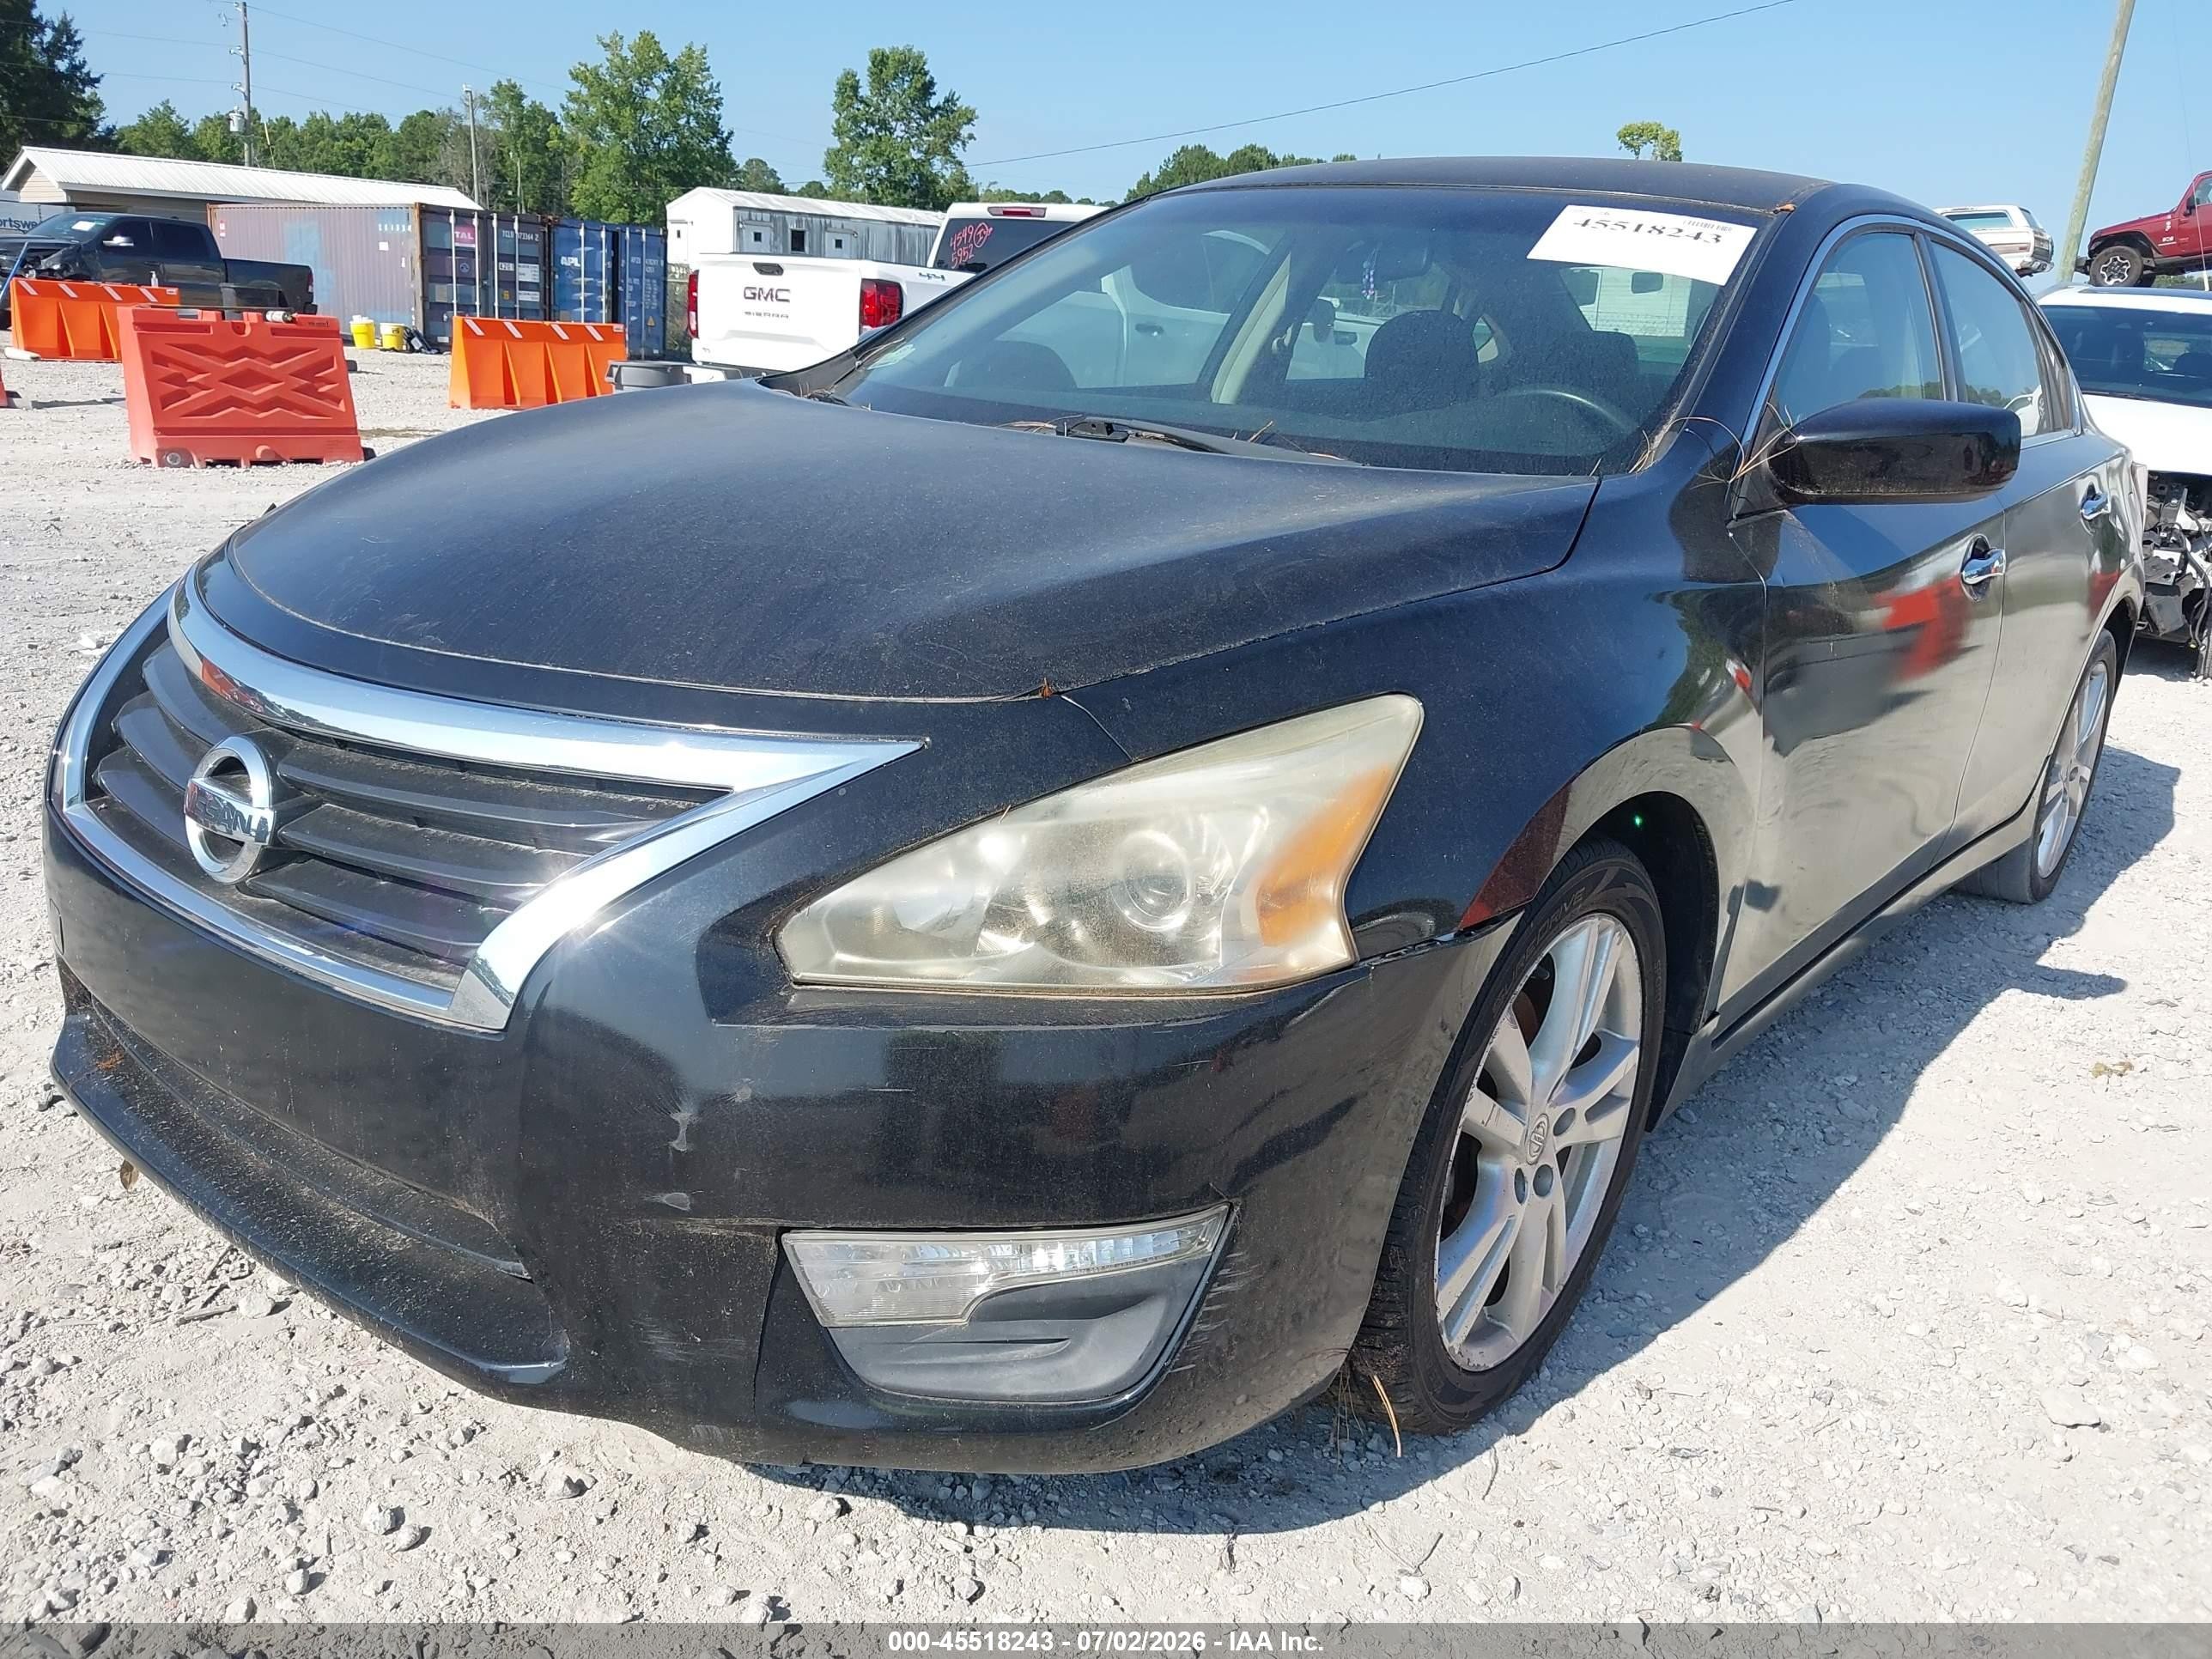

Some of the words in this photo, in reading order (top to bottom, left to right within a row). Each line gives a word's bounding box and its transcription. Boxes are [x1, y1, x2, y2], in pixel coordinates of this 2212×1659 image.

[454, 231, 474, 240] TAL
[950, 225, 974, 251] 4549
[1573, 217, 1723, 244] 45518243
[560, 256, 580, 267] APL
[951, 244, 975, 269] 5952
[744, 286, 790, 302] GMC
